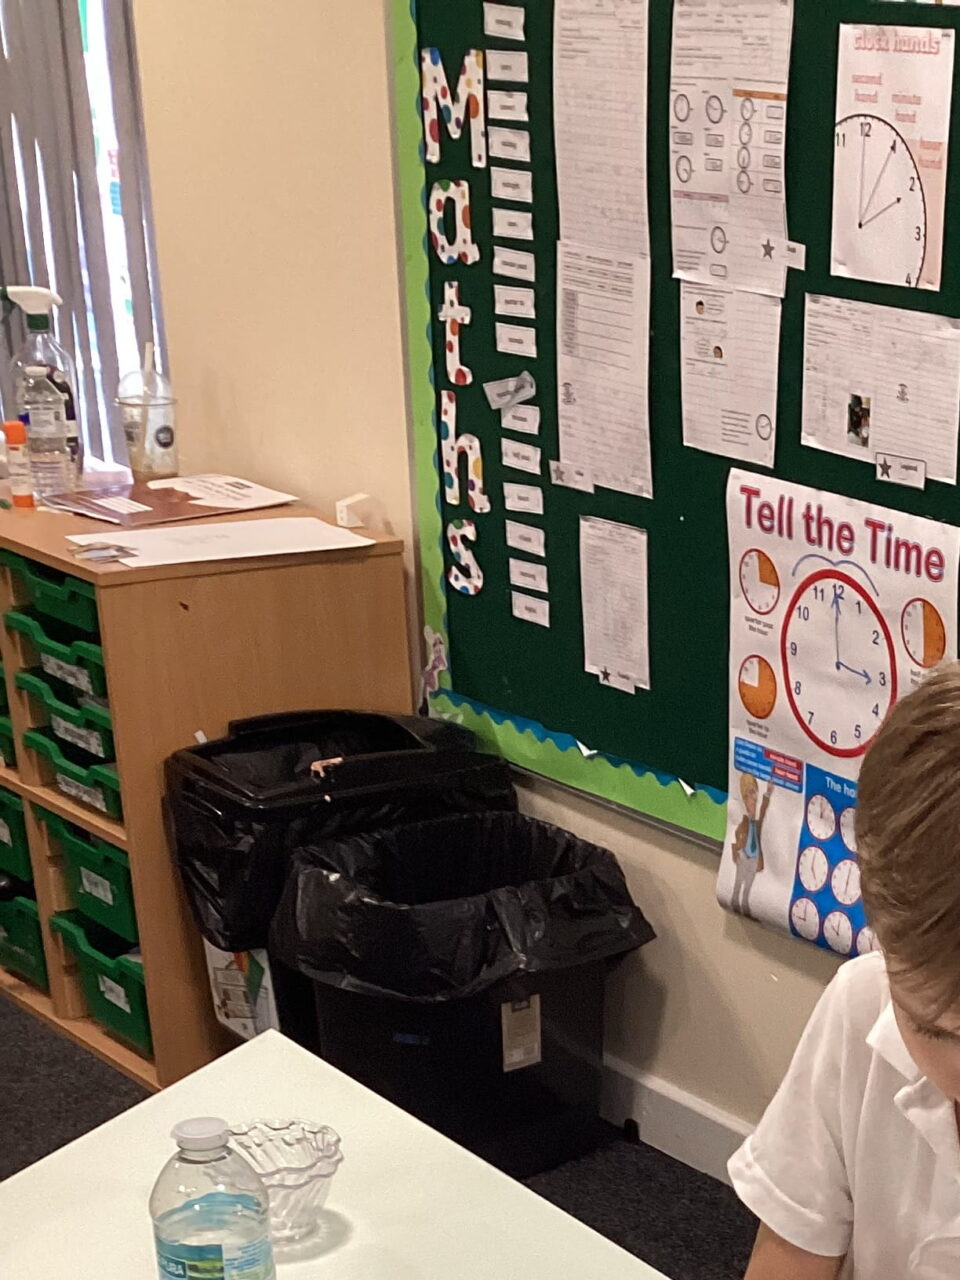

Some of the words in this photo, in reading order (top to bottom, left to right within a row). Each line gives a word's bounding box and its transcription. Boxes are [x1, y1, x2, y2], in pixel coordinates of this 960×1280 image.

[860, 122, 872, 138] 12
[836, 133, 846, 148] 11
[909, 176, 915, 192] 2
[915, 226, 921, 241] 3
[905, 272, 912, 288] 4
[421, 47, 488, 597] Maths
[740, 484, 794, 540] Tell
[803, 502, 855, 556] the
[864, 517, 945, 583] Time
[813, 585, 825, 602] 11
[832, 583, 845, 600] 12
[797, 606, 810, 622] 10
[855, 600, 862, 615] 1
[872, 629, 880, 646] 2
[790, 641, 798, 656] 9
[879, 671, 887, 687] 3
[794, 681, 802, 696] 8
[807, 711, 815, 726] 7
[872, 703, 880, 718] 4
[830, 730, 838, 745] 6
[854, 724, 862, 739] 5
[825, 776, 842, 792] The
[843, 782, 857, 799] ho
